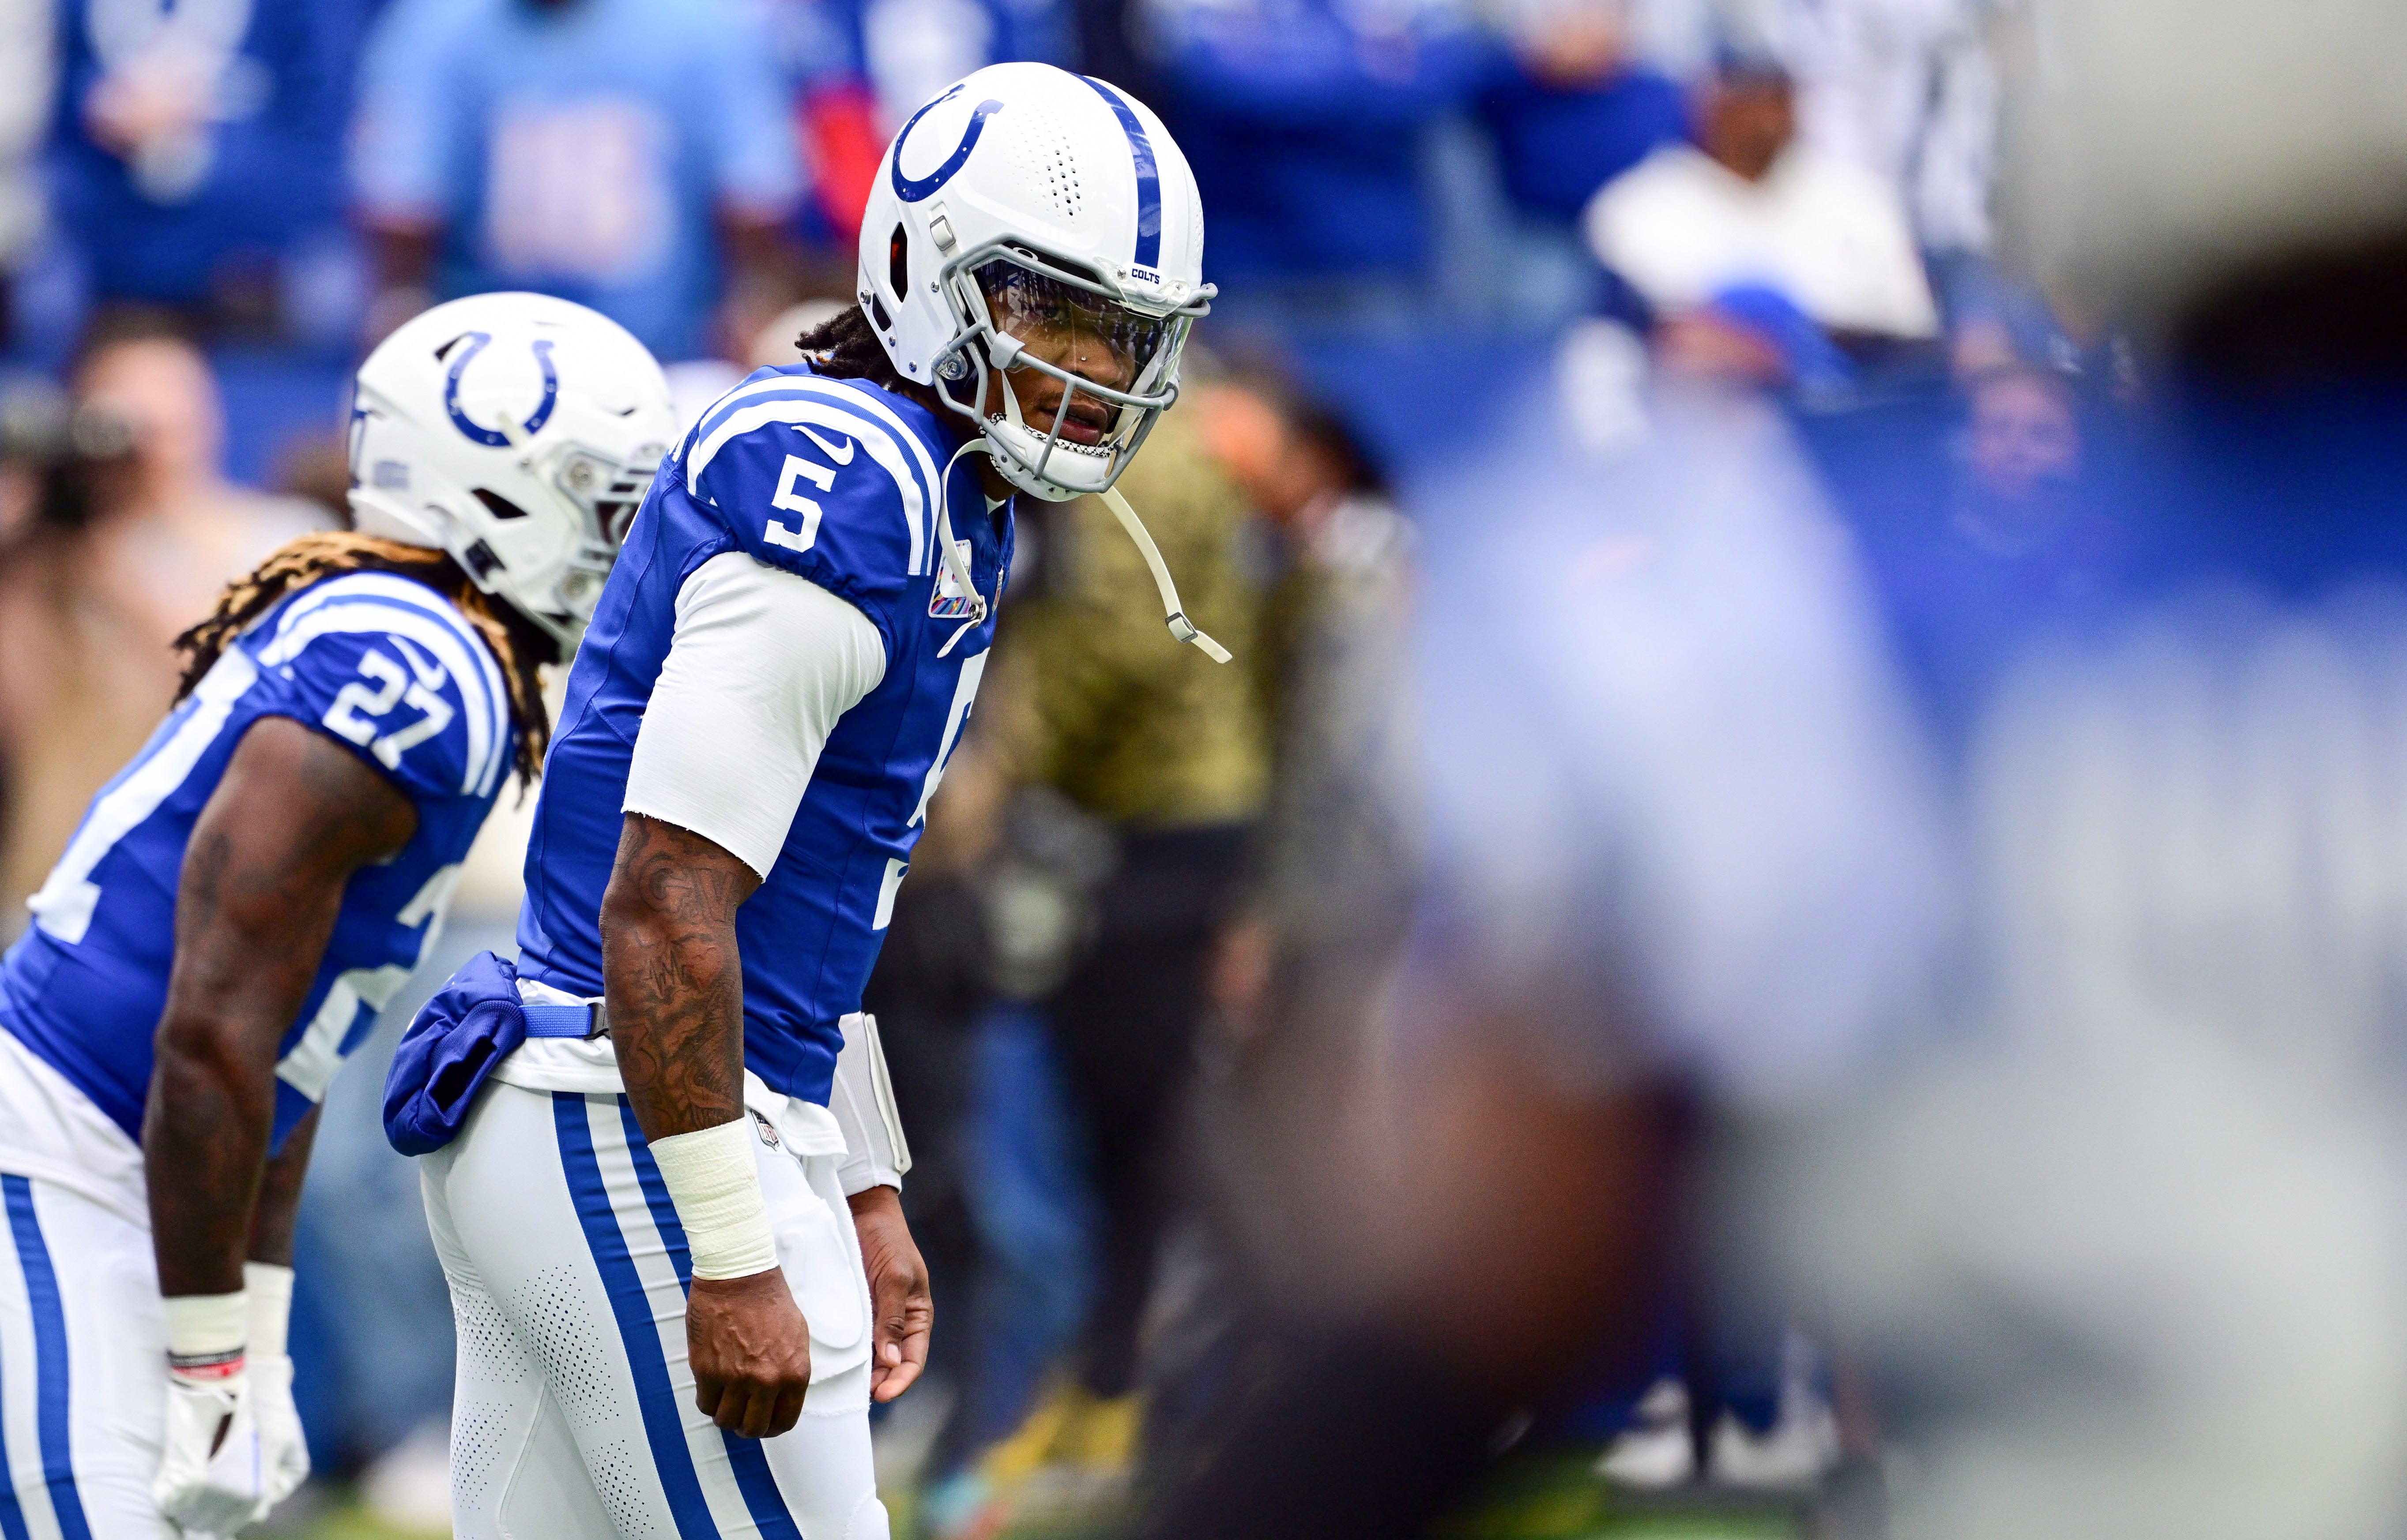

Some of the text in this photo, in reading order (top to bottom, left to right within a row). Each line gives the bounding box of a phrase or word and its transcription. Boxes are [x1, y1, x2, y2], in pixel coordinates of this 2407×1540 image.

[1131, 268, 1160, 285] COLTS
[763, 454, 836, 553] 5
[322, 648, 455, 771] 27
